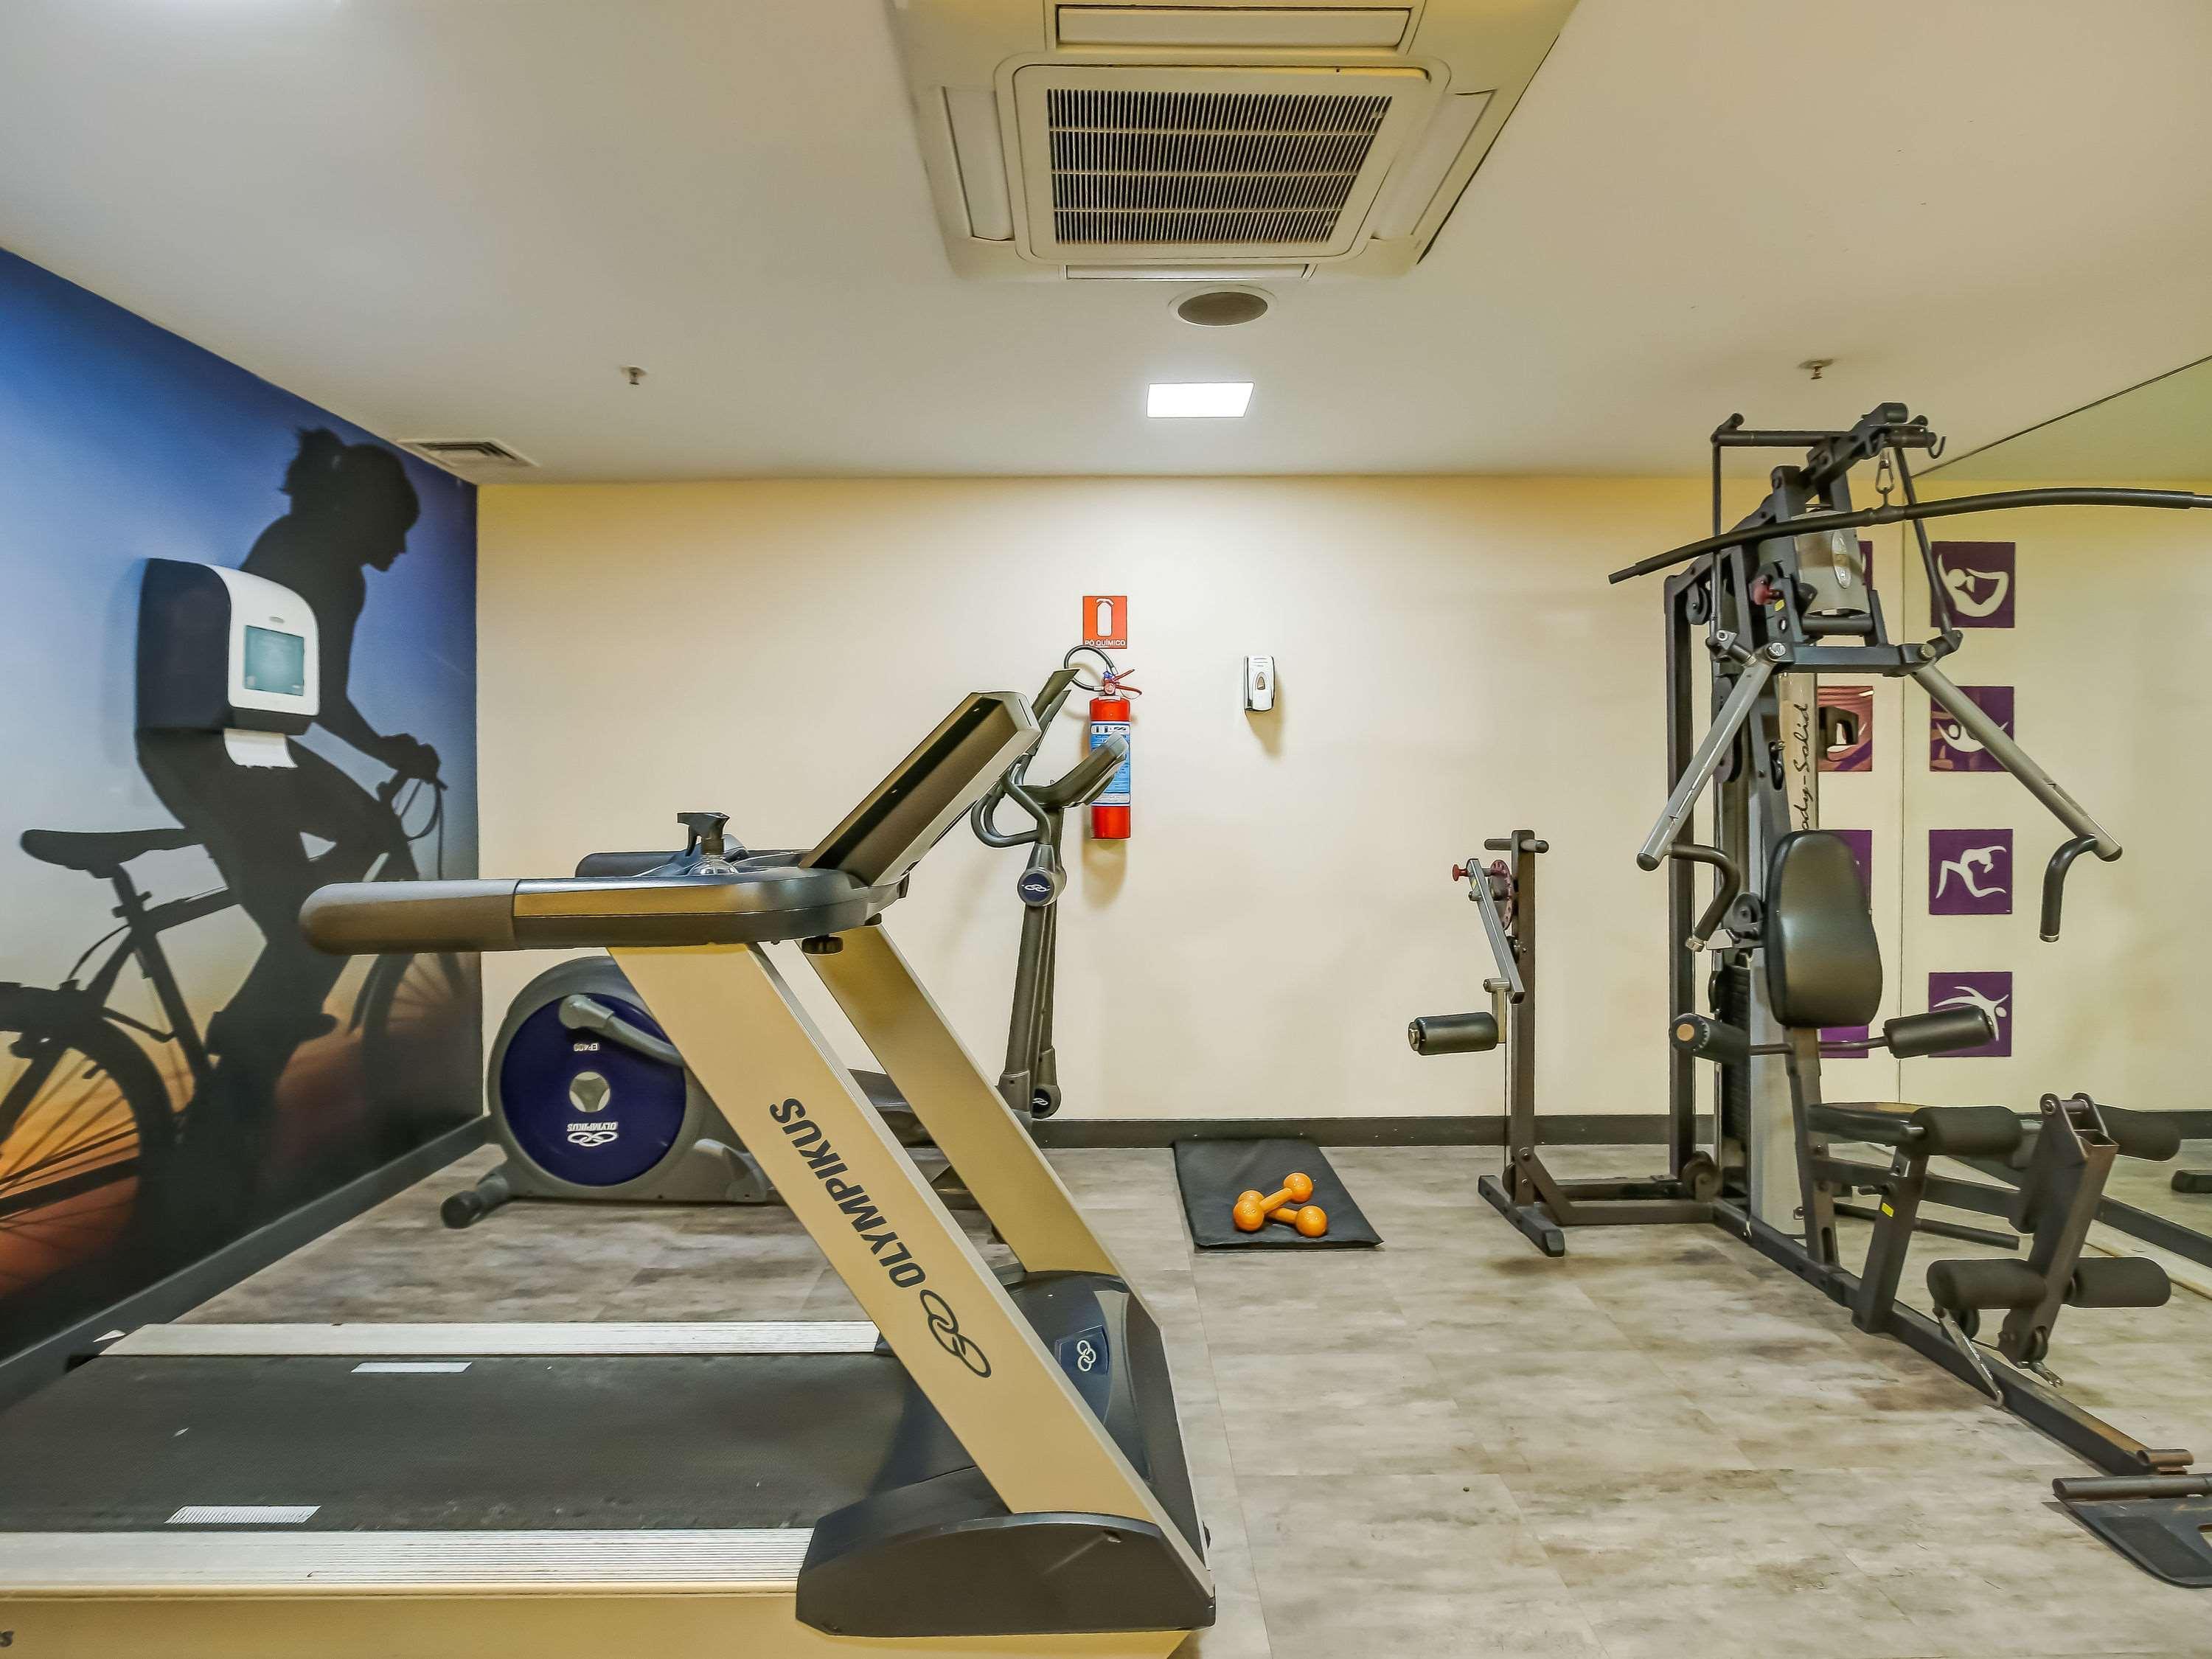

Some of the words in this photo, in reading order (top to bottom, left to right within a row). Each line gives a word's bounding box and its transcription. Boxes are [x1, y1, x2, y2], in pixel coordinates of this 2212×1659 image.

[1793, 703, 1813, 831] ody-Solid
[567, 1121, 619, 1131] OLYMPIKUS
[769, 1098, 927, 1288] OLYMPIKUS
